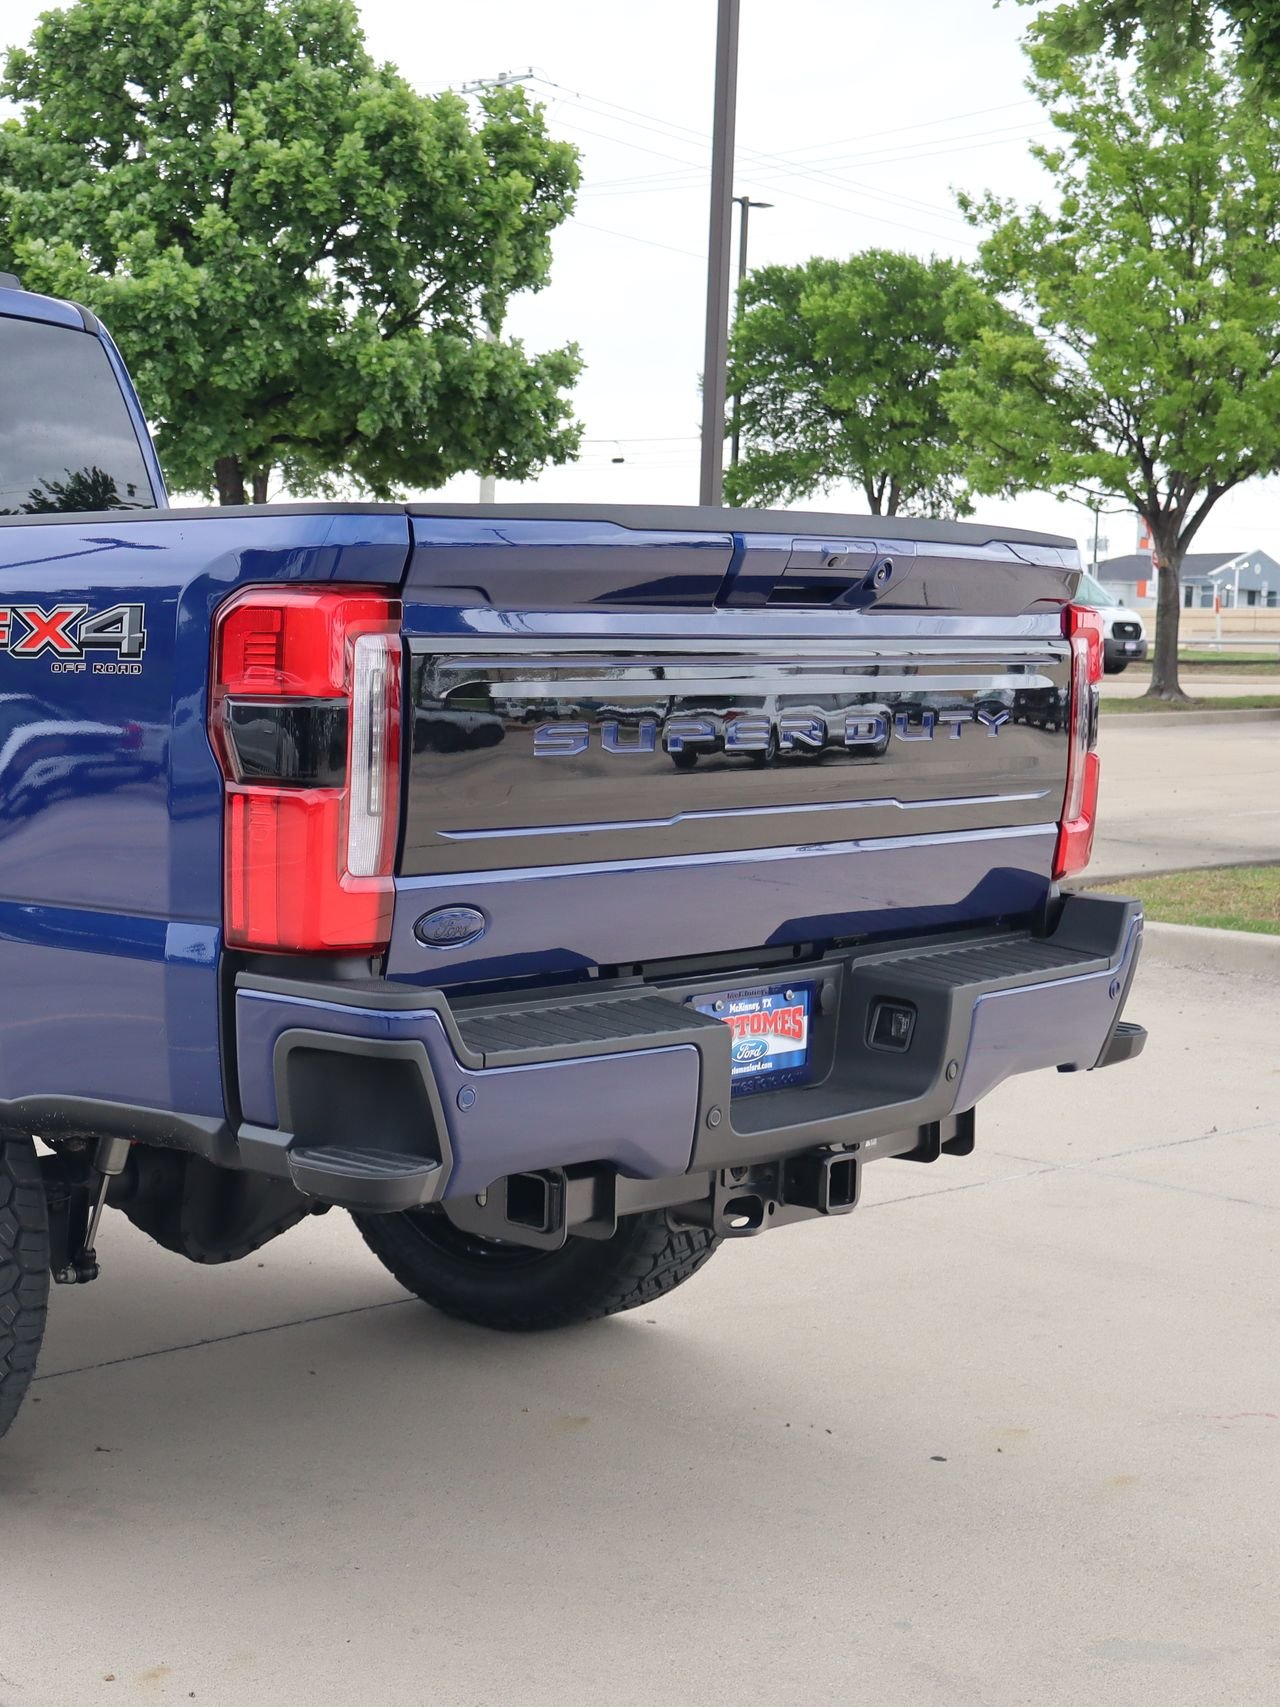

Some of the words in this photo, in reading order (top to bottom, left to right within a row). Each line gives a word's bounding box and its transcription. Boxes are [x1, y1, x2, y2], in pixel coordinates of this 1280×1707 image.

[51, 662, 87, 674] OFF
[92, 663, 143, 675] ROAD
[533, 713, 825, 757] SUPER
[844, 709, 1010, 745] DUTY
[761, 998, 773, 1009] TX
[736, 1042, 763, 1060] Ford
